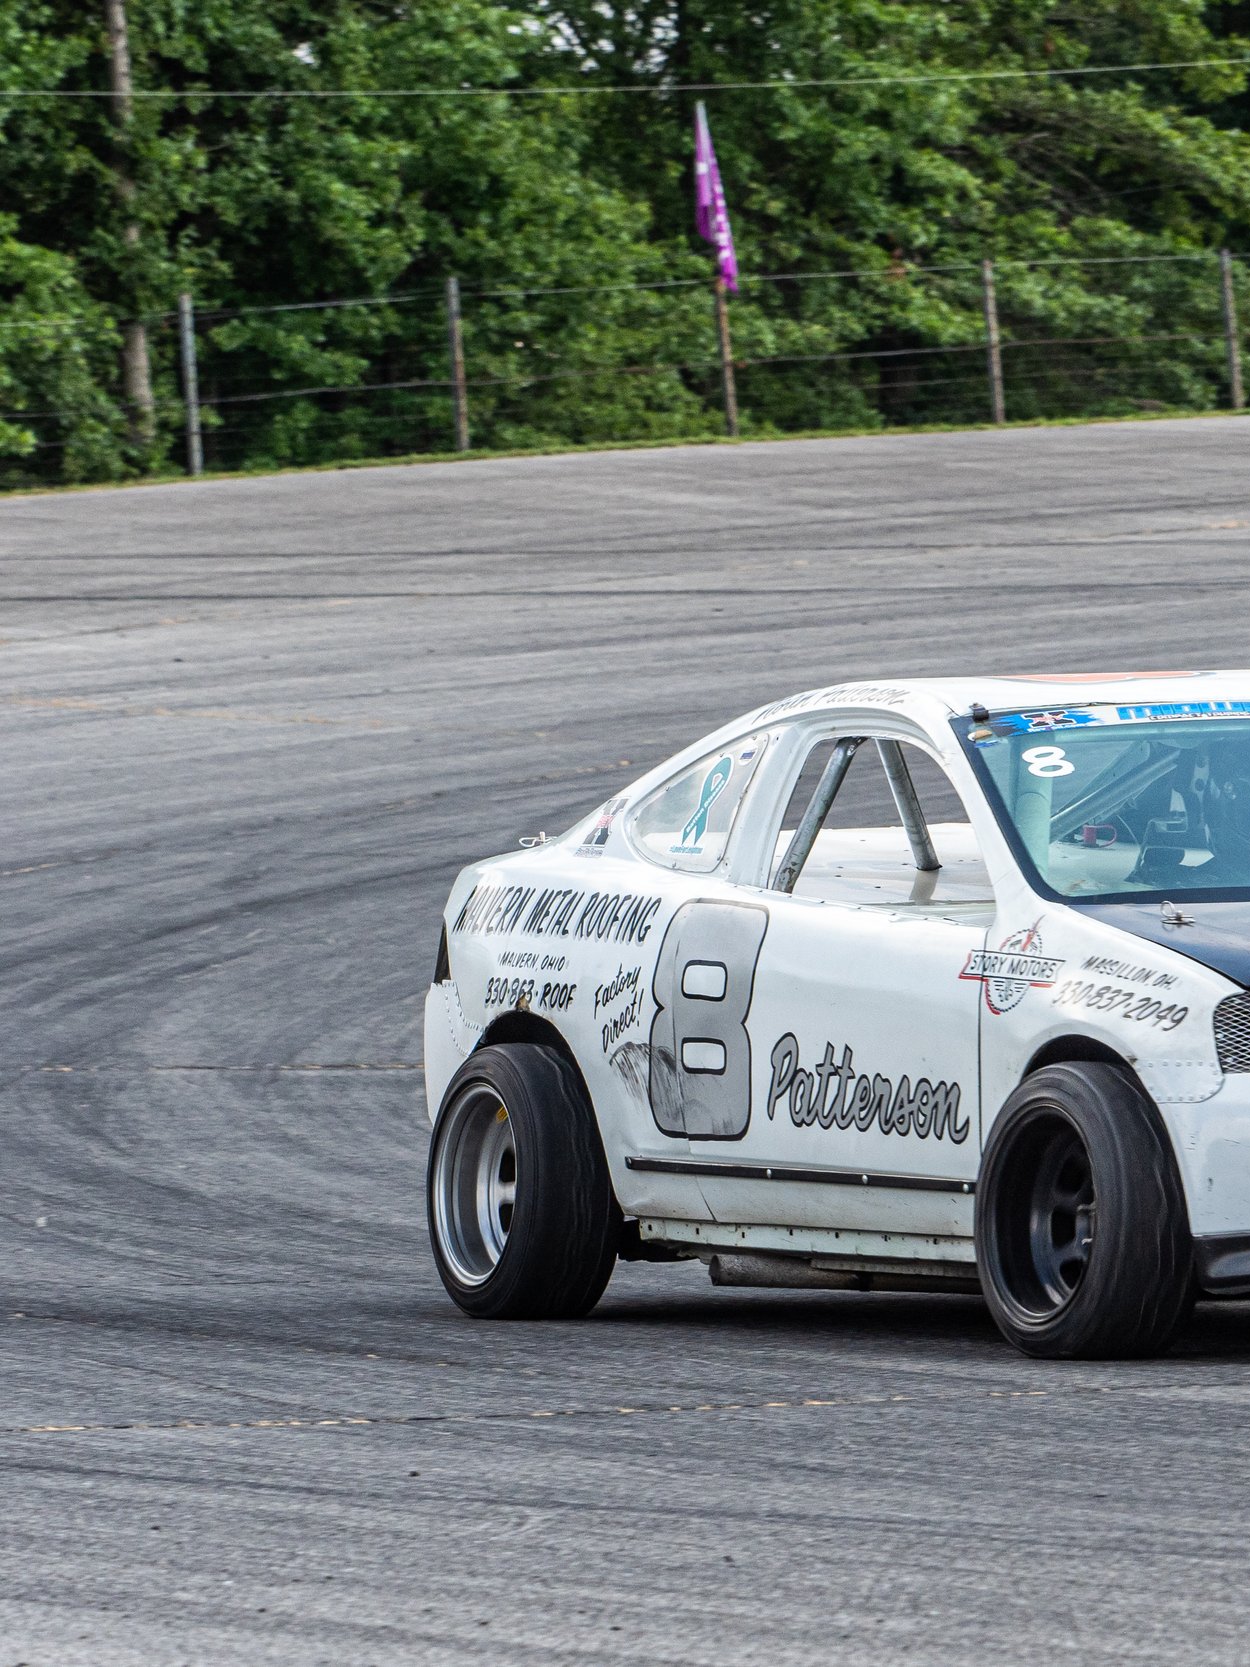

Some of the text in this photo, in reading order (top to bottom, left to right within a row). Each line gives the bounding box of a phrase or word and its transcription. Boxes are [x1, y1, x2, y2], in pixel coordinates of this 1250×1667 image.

[1022, 745, 1075, 777] 8
[453, 884, 662, 944] MALVERN METAL ROOFING
[540, 955, 566, 972] OHIO
[593, 963, 642, 1020] Factory
[970, 954, 1057, 979] STORY MOTORS
[602, 988, 645, 1053] Direct!
[649, 897, 770, 1142] 8
[1050, 980, 1189, 1032] 330-837-2049
[768, 1031, 970, 1145] Patterson
